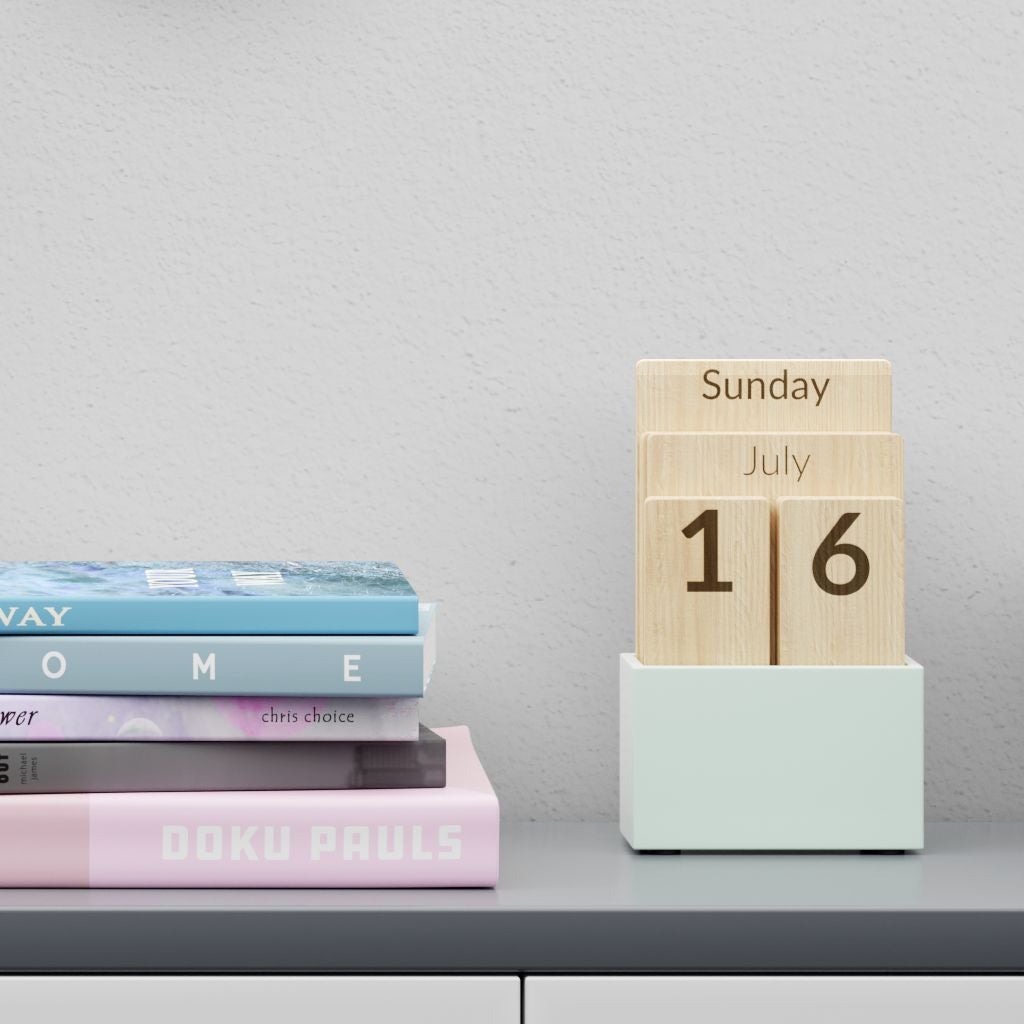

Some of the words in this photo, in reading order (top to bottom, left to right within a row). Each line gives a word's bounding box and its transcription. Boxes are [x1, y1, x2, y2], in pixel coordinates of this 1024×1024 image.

[702, 369, 830, 406] Sunday
[744, 446, 811, 481] July
[681, 509, 733, 593] 1
[812, 512, 870, 596] 6
[261, 707, 298, 723] chris
[304, 707, 355, 724] choice
[161, 824, 291, 861] DOKU
[310, 824, 463, 861] PAULS
